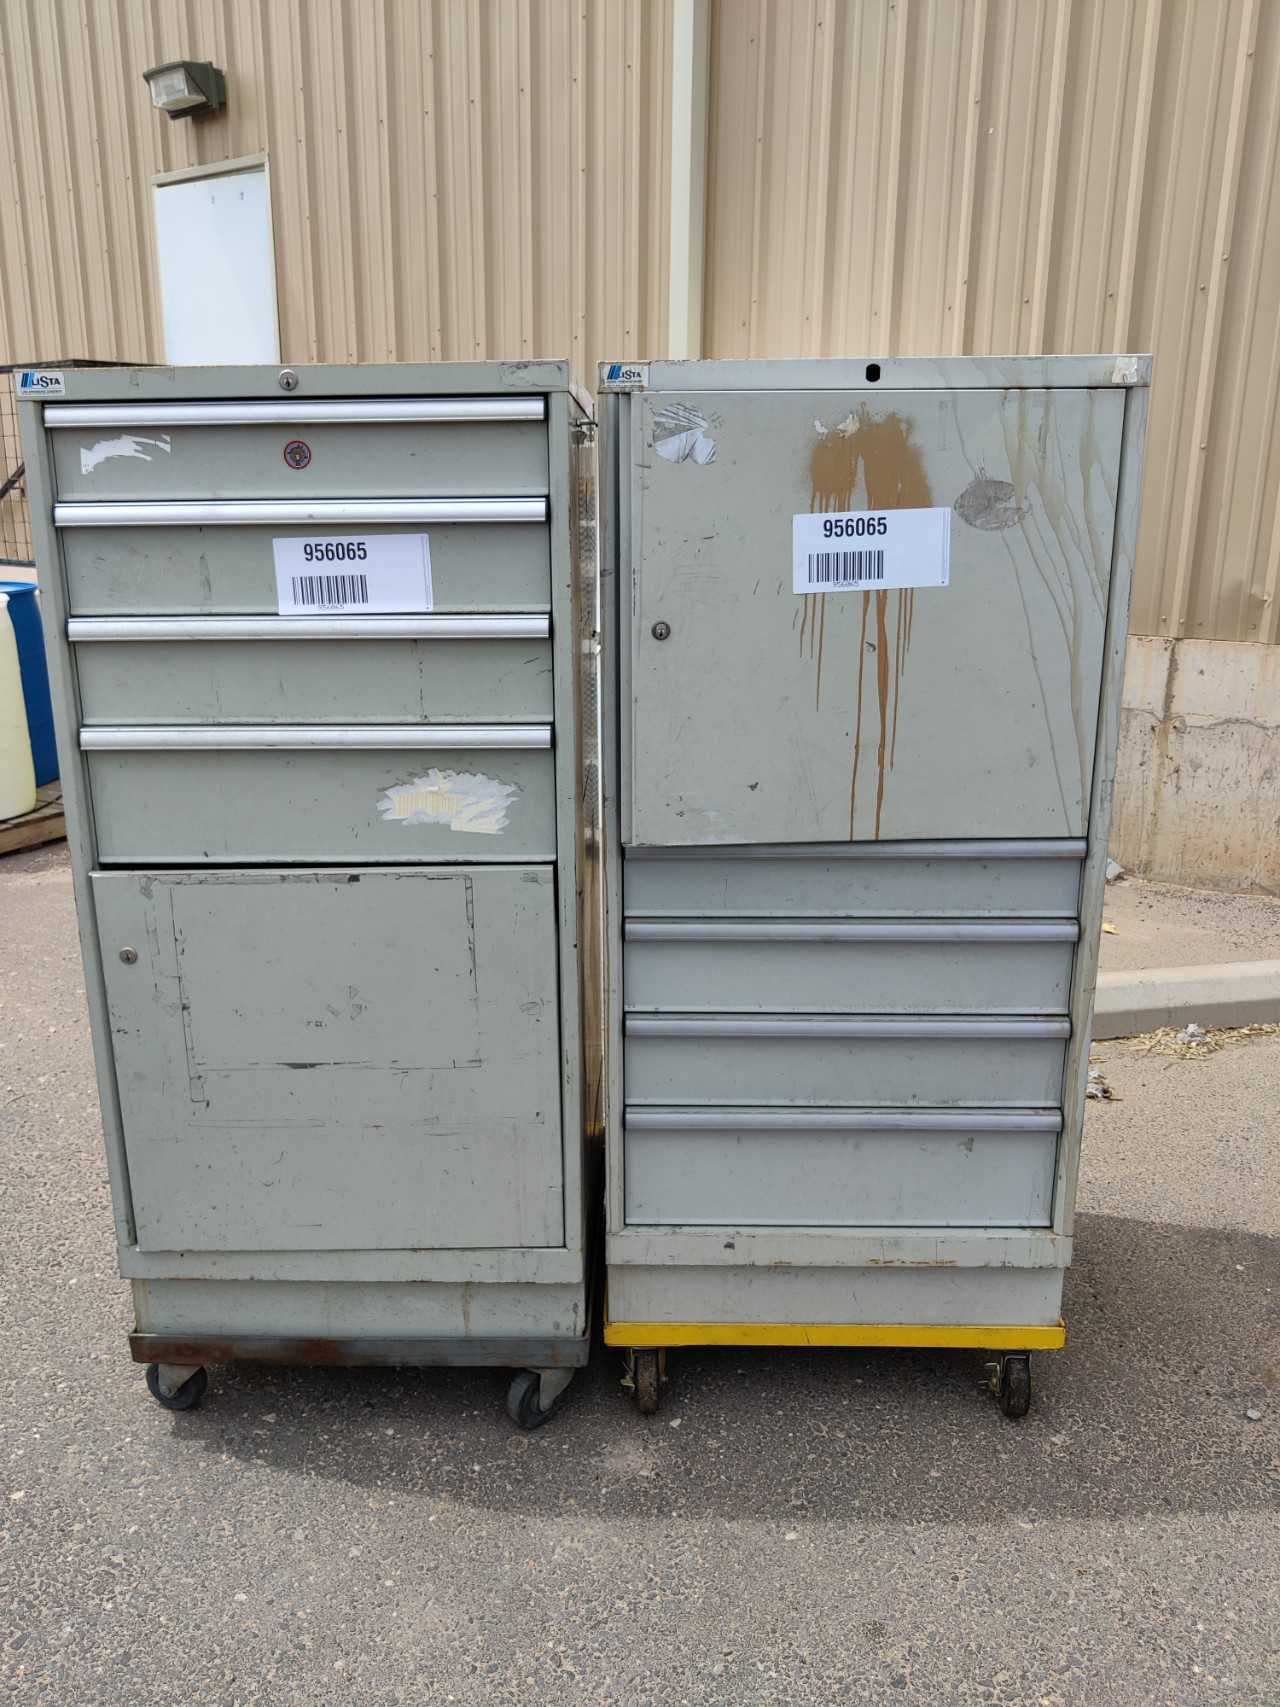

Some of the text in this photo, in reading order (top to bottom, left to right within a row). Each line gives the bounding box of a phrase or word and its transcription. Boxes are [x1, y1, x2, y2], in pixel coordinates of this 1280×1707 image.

[31, 376, 61, 388] LISTA
[823, 517, 888, 538] 956065
[303, 542, 368, 562] 956065
